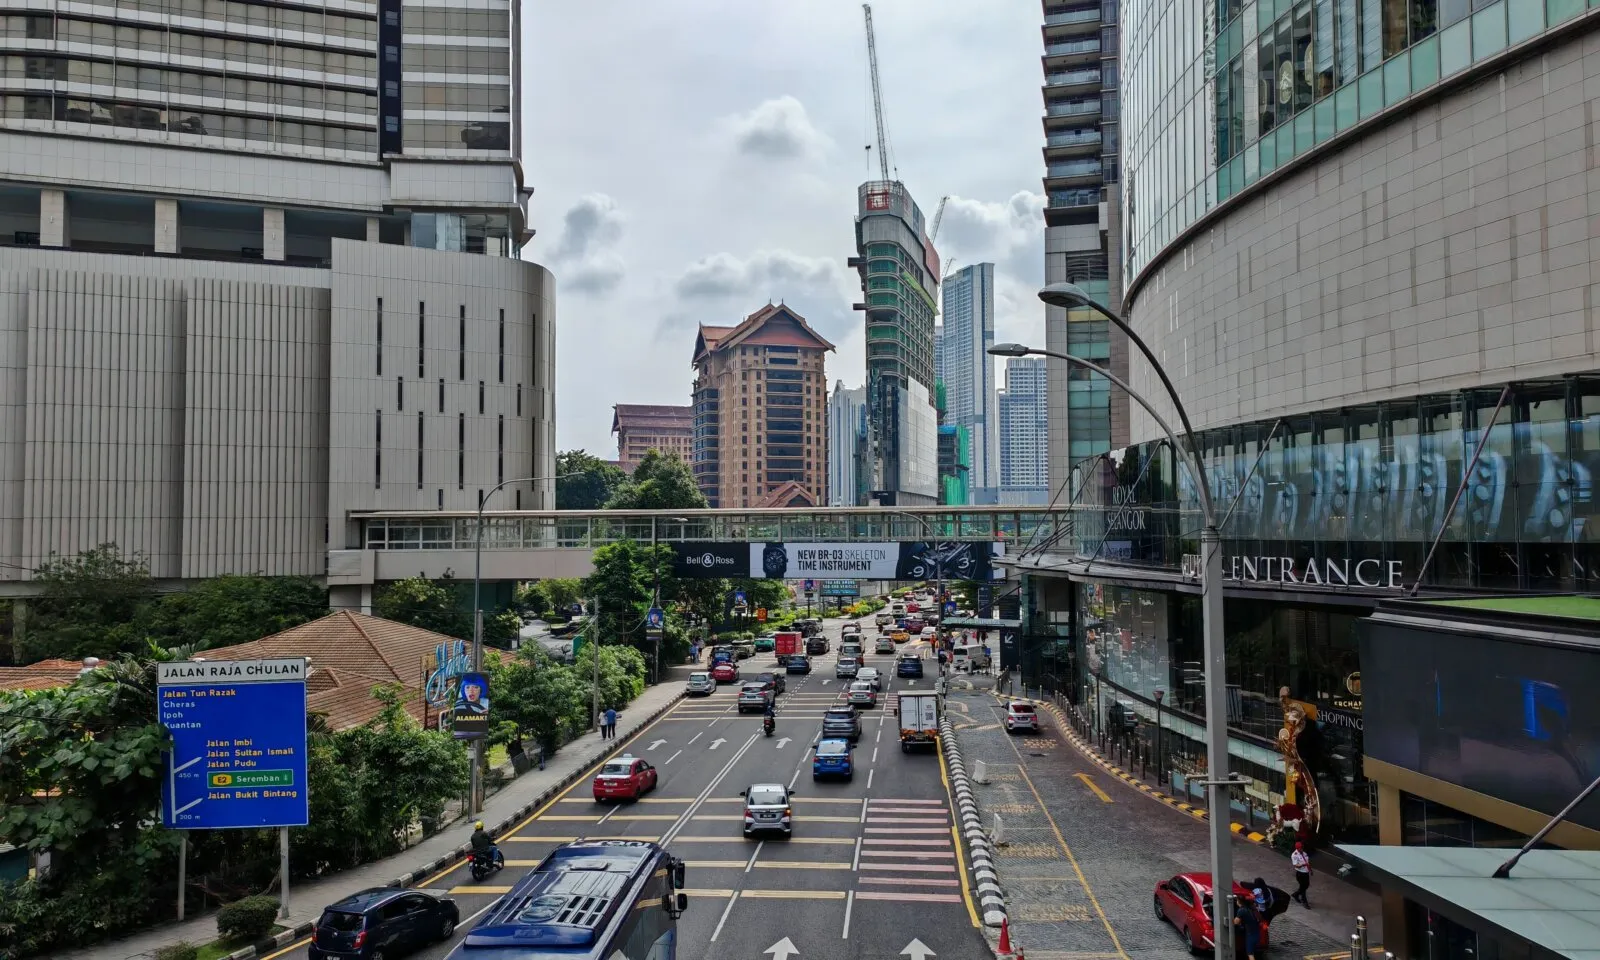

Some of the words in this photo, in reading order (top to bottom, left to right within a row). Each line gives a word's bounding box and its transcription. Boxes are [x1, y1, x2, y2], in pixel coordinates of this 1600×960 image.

[1112, 485, 1136, 504] ROYAL
[1108, 510, 1146, 530] SELANGOR
[686, 556, 701, 564] Bell
[715, 556, 734, 564] Ross
[798, 550, 816, 560] NEW
[818, 550, 842, 560] BR-03
[844, 550, 886, 560] SKELETON
[798, 560, 816, 570] TIME
[819, 560, 872, 570] INSTRUMENT
[958, 558, 969, 569] 3
[914, 566, 924, 577] 9
[1232, 555, 1404, 588] ENTRANCE
[164, 668, 205, 677] JALAN
[210, 666, 241, 676] RAJA
[247, 664, 299, 675] CHULAN
[1317, 710, 1363, 730] SHOPPING
